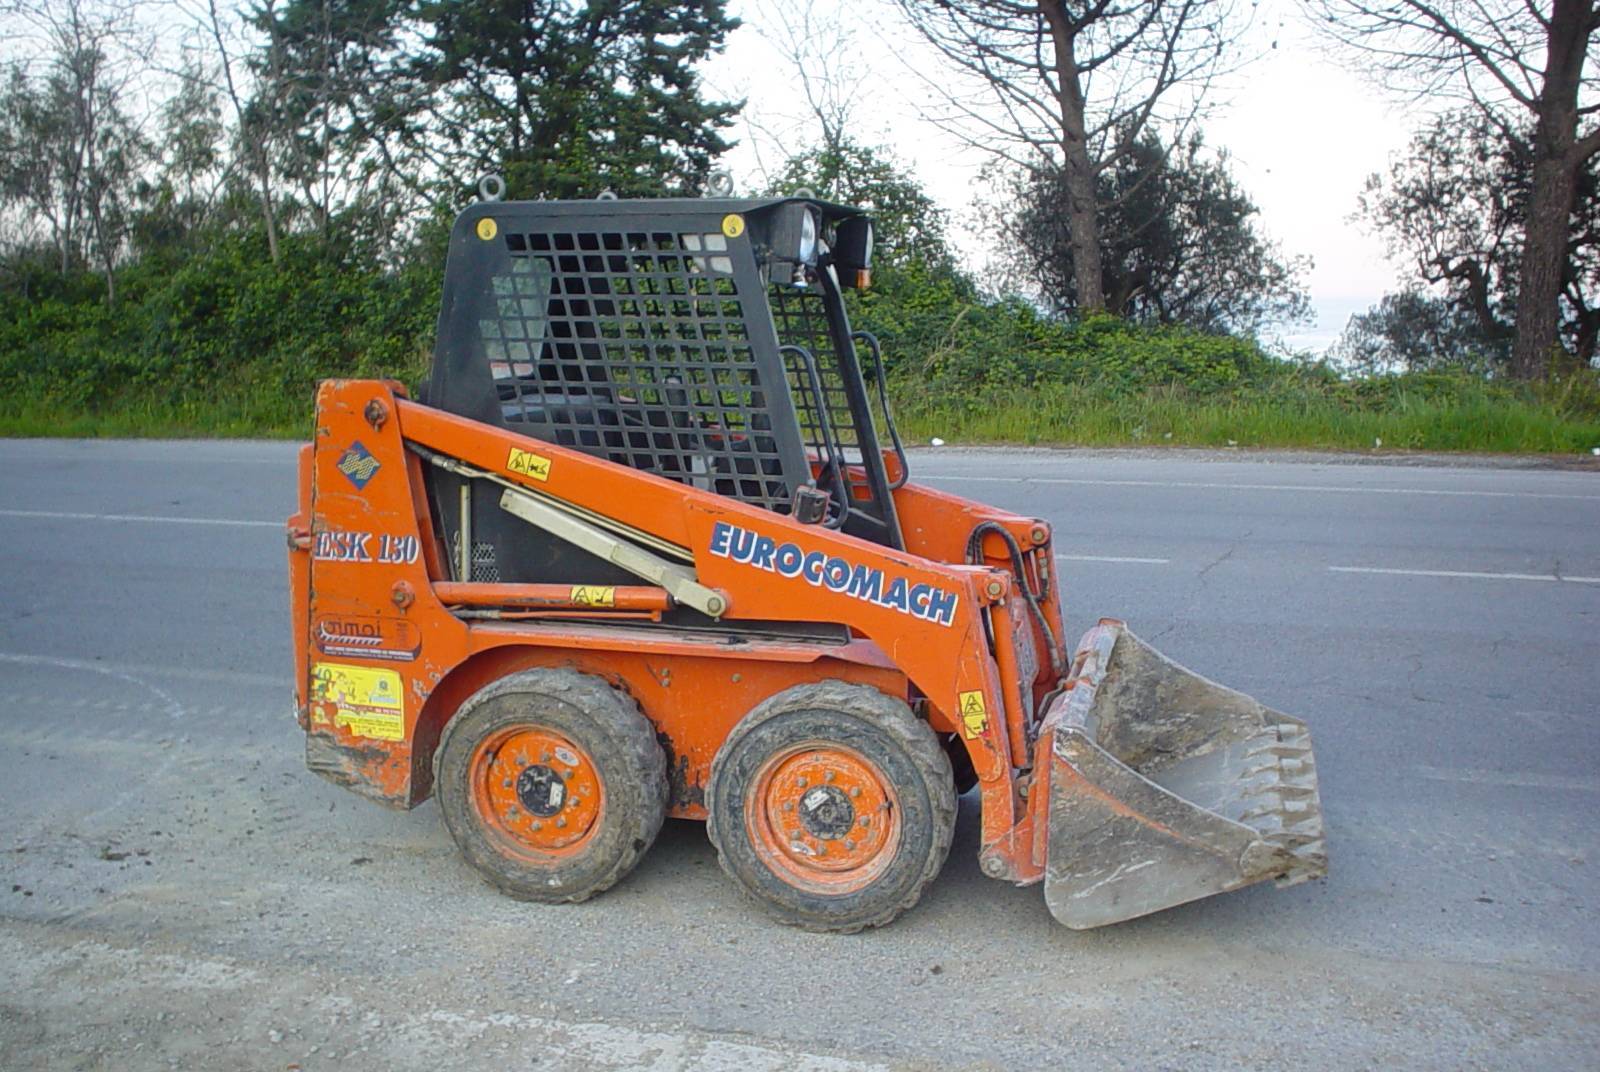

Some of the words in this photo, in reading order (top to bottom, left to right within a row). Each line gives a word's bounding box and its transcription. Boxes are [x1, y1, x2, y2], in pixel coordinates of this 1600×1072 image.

[315, 532, 373, 563] ESK
[378, 535, 419, 564] 130
[711, 522, 958, 627] EUROCOMACH
